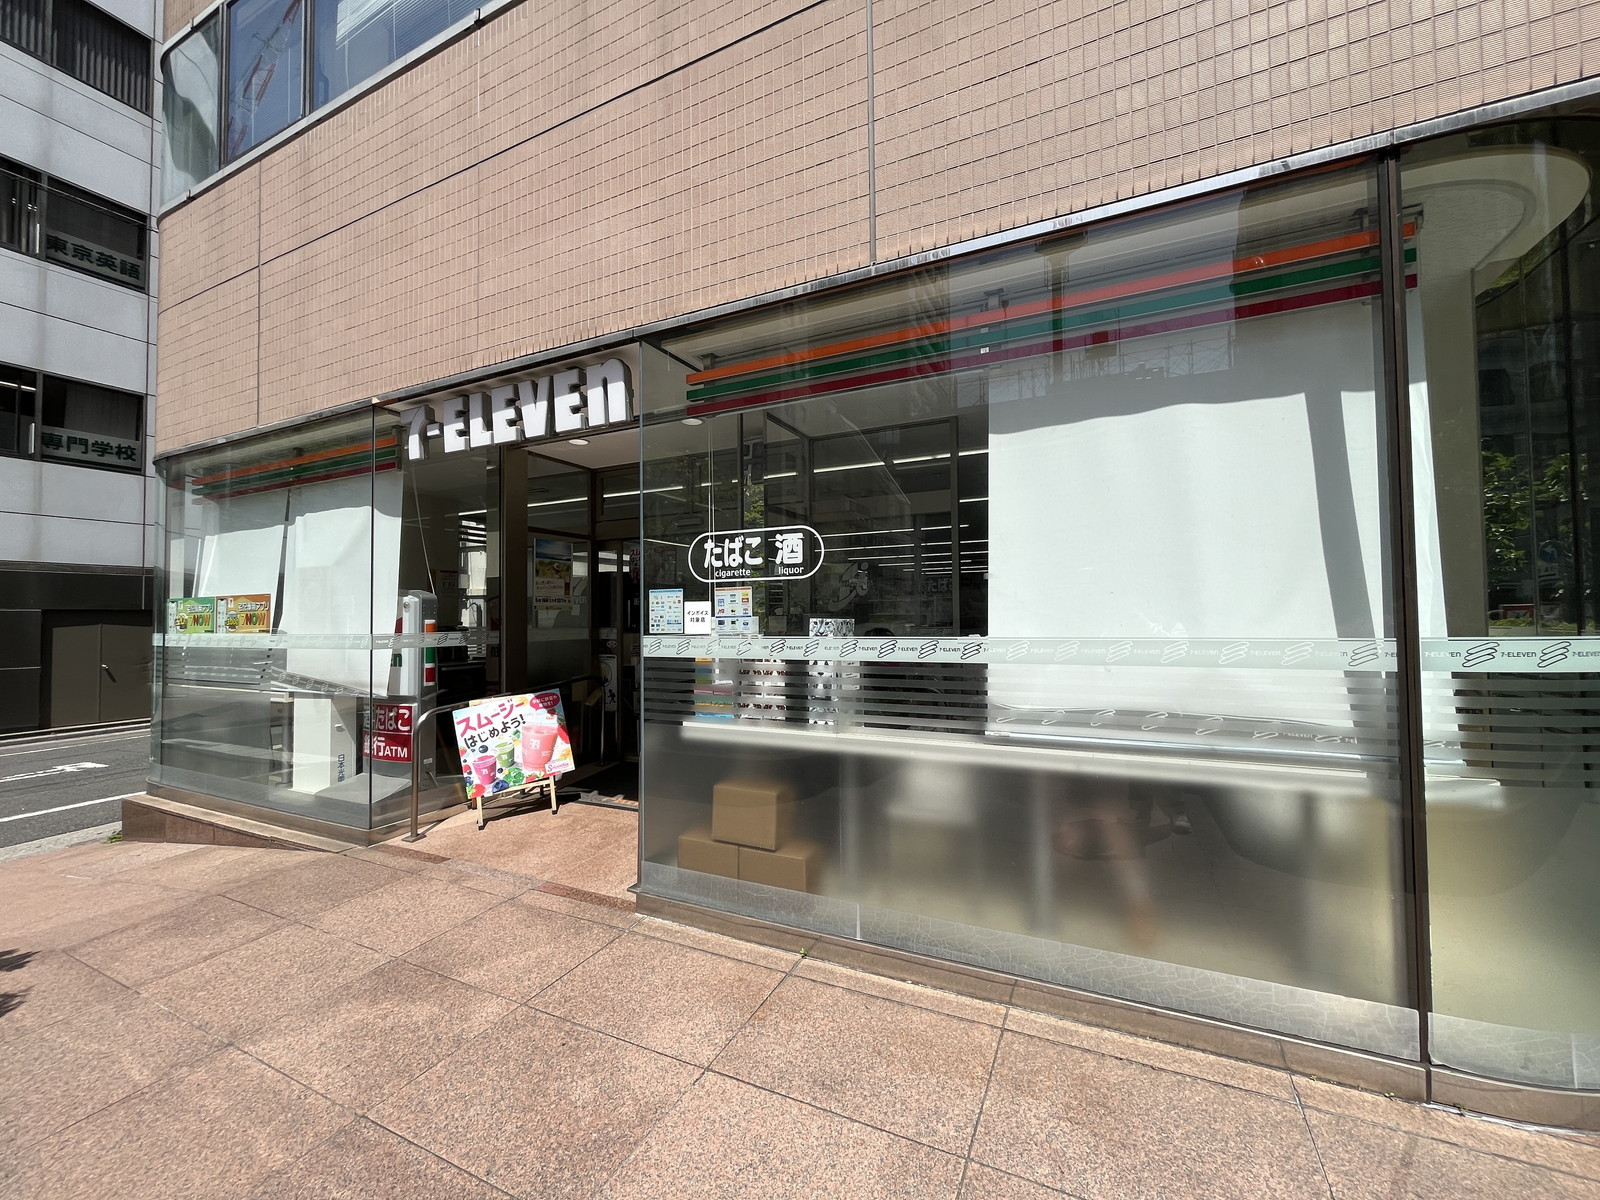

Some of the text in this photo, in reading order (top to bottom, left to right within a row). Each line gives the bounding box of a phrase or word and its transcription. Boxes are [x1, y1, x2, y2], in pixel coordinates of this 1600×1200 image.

[46, 233, 141, 281] 東京英語
[41, 432, 137, 462] 専門学校
[704, 532, 804, 568] たばこ 酒
[715, 566, 804, 578] cigarette liquor
[456, 698, 525, 737] スムージー
[463, 713, 527, 749] はじめよう!
